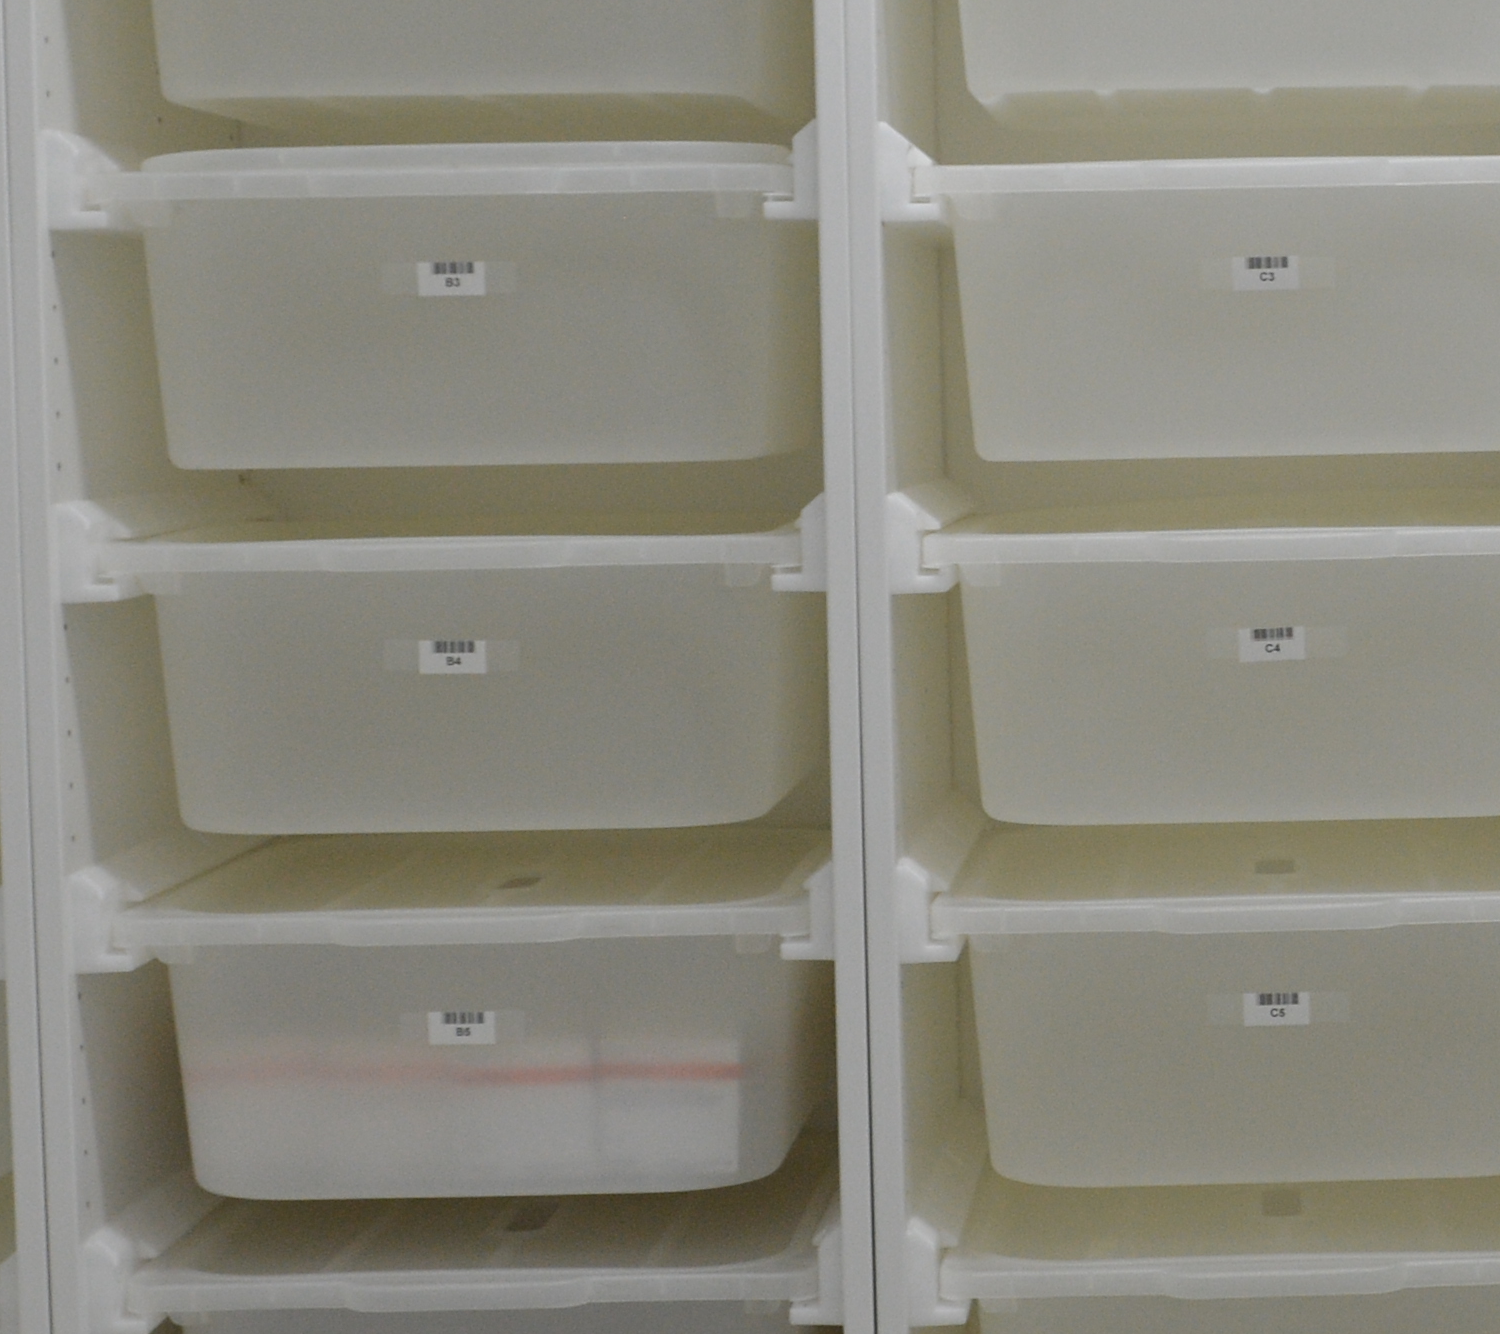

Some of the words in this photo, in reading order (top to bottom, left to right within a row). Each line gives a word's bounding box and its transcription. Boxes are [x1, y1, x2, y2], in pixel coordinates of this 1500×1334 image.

[444, 276, 462, 289] B3
[1258, 271, 1276, 283] C3
[1264, 642, 1282, 654] C4
[445, 655, 463, 667] B4
[1269, 1007, 1287, 1019] C5
[455, 1026, 472, 1038] B5
